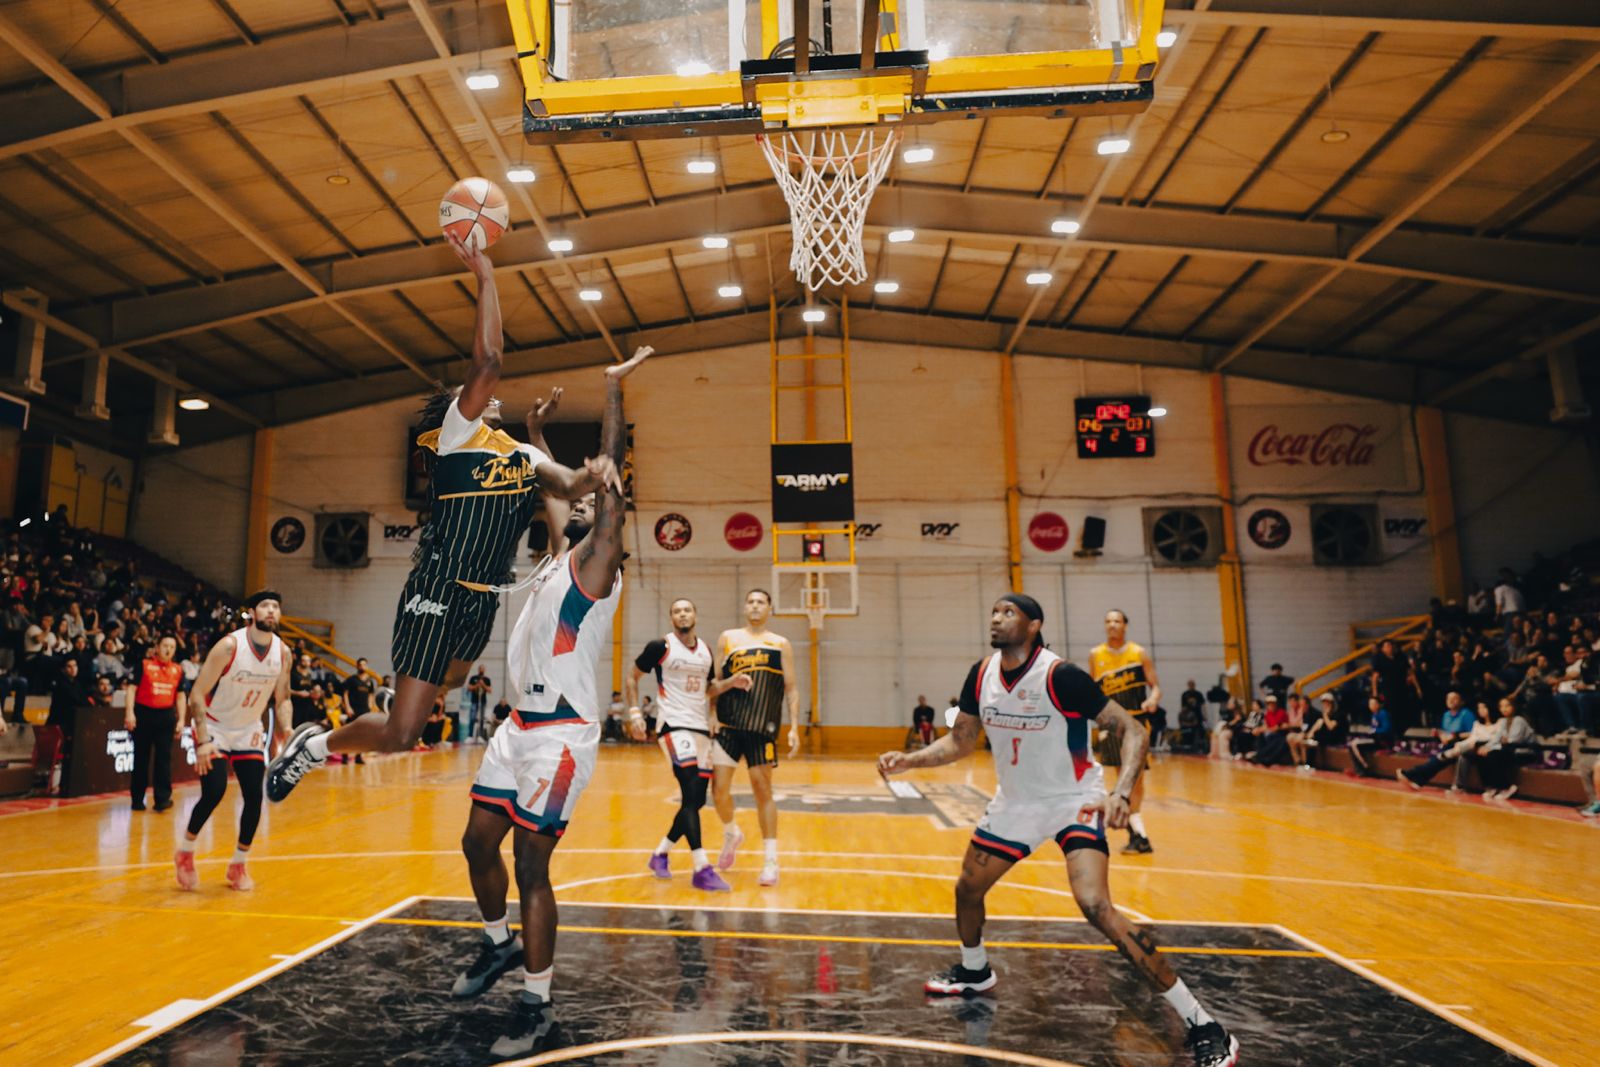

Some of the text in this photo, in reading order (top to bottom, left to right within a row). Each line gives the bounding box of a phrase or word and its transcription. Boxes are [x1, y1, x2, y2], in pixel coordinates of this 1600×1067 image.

[1248, 424, 1380, 467] Coca-Cola
[775, 472, 849, 488] ARMY
[525, 777, 550, 809] 7
